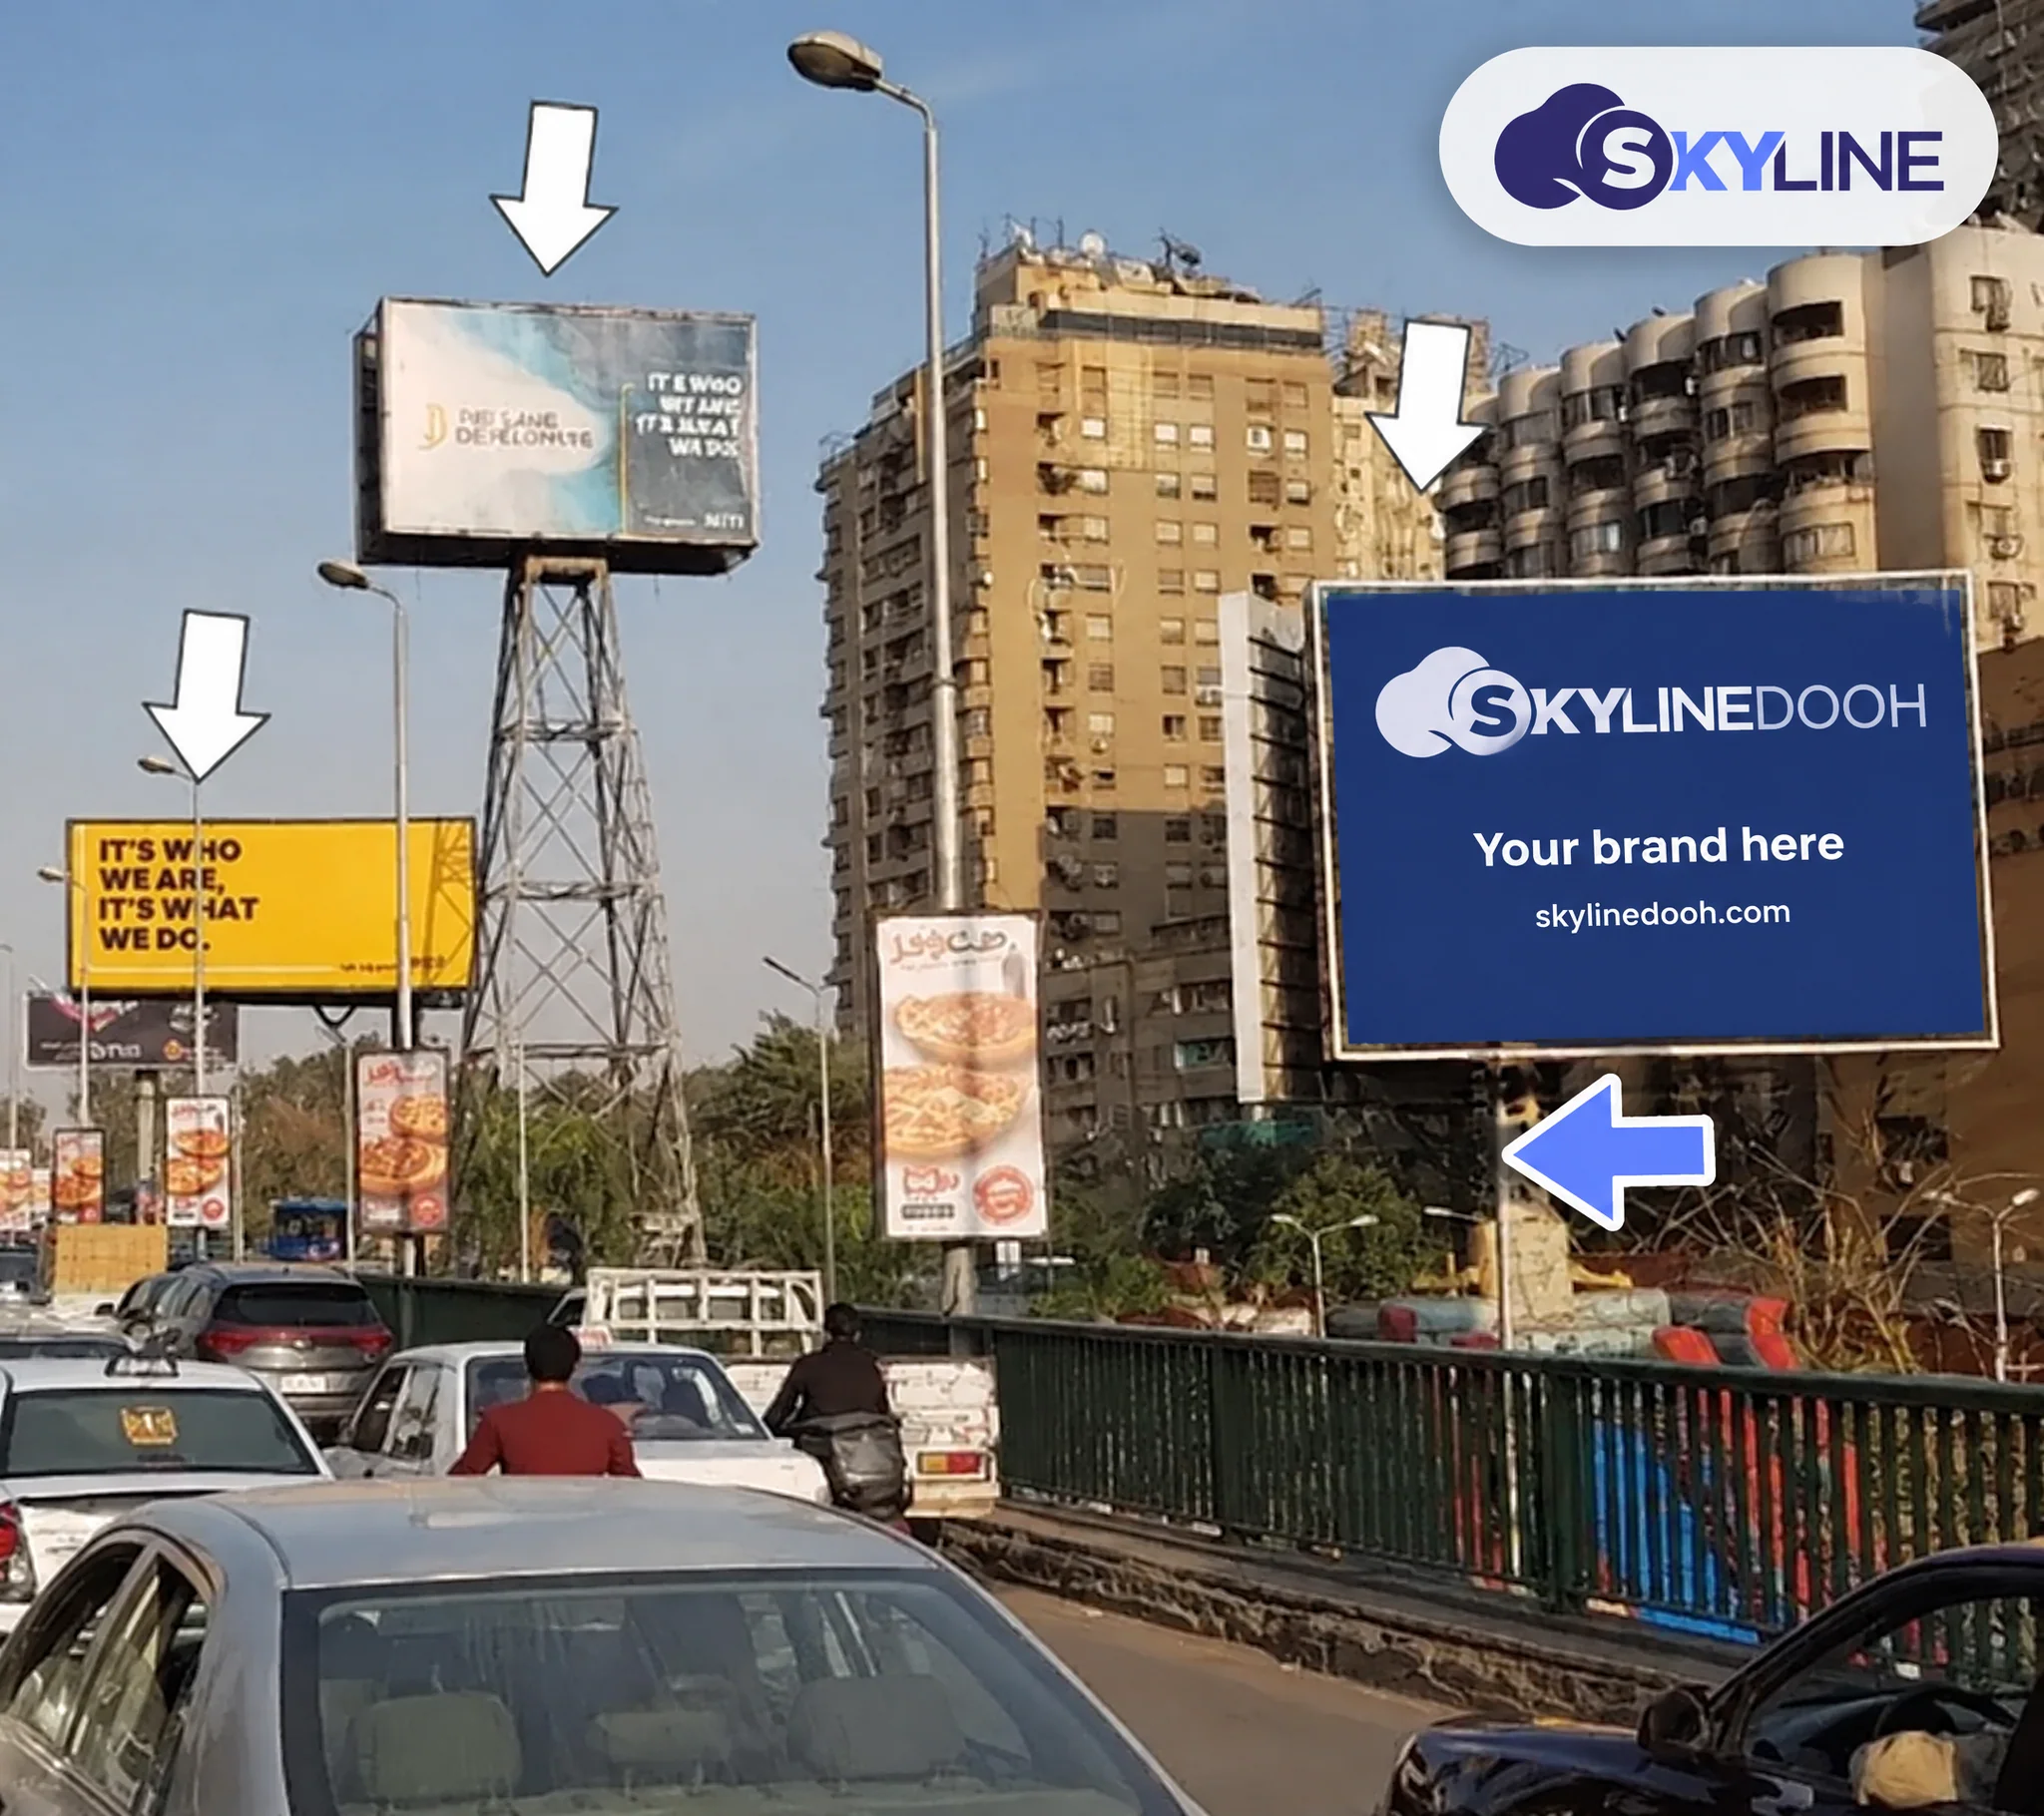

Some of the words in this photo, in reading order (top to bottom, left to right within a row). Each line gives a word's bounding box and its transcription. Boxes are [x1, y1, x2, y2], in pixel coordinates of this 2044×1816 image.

[100, 838, 156, 862] IT'S
[162, 838, 243, 863] WHO
[1472, 830, 1579, 868] Your
[1592, 826, 1728, 866] brand
[1742, 825, 1844, 863] here
[99, 867, 150, 891] WE
[156, 867, 226, 896] ARE,
[99, 897, 156, 921] IT'S
[162, 897, 259, 921] WHAT
[1535, 901, 1791, 934] skylinedooh.com
[99, 926, 150, 950] WE
[156, 926, 212, 951] DO.
